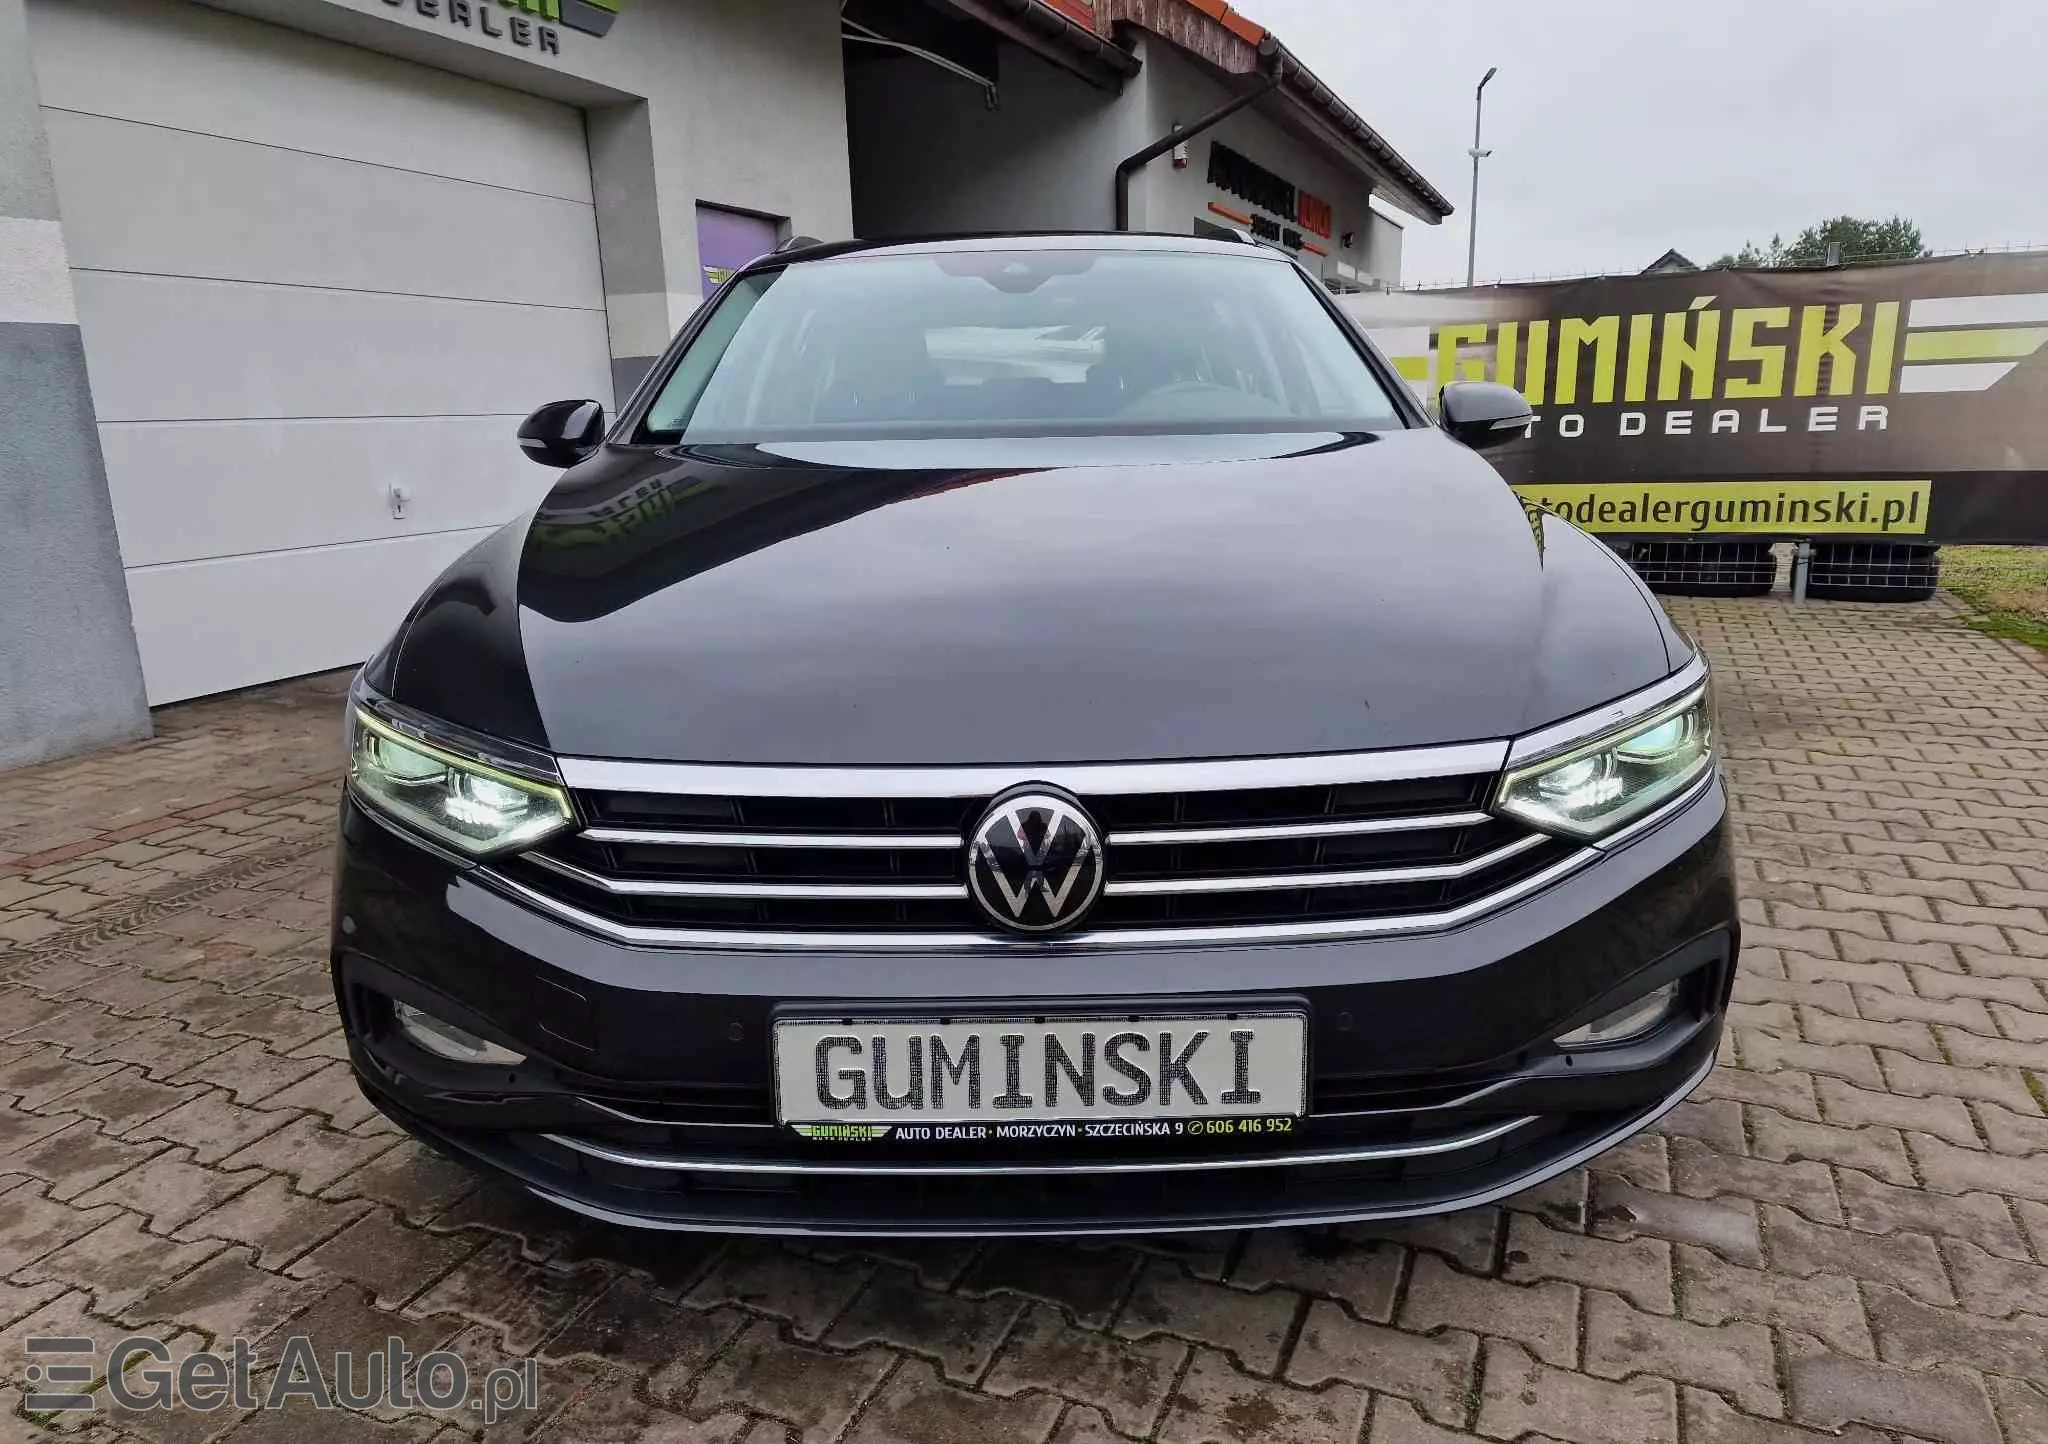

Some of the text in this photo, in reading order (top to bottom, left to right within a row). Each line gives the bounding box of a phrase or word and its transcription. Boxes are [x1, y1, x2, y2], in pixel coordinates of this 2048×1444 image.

[382, 0, 560, 54] EALER
[1436, 296, 1900, 408] GUMIŃSKI
[1620, 405, 1889, 437] DEALER
[815, 1030, 1262, 1110] GUMINSKI
[896, 1118, 1292, 1139] AUTO DEALER MORZYCZYN SZCZECIŃSKA 9 606 416 952
